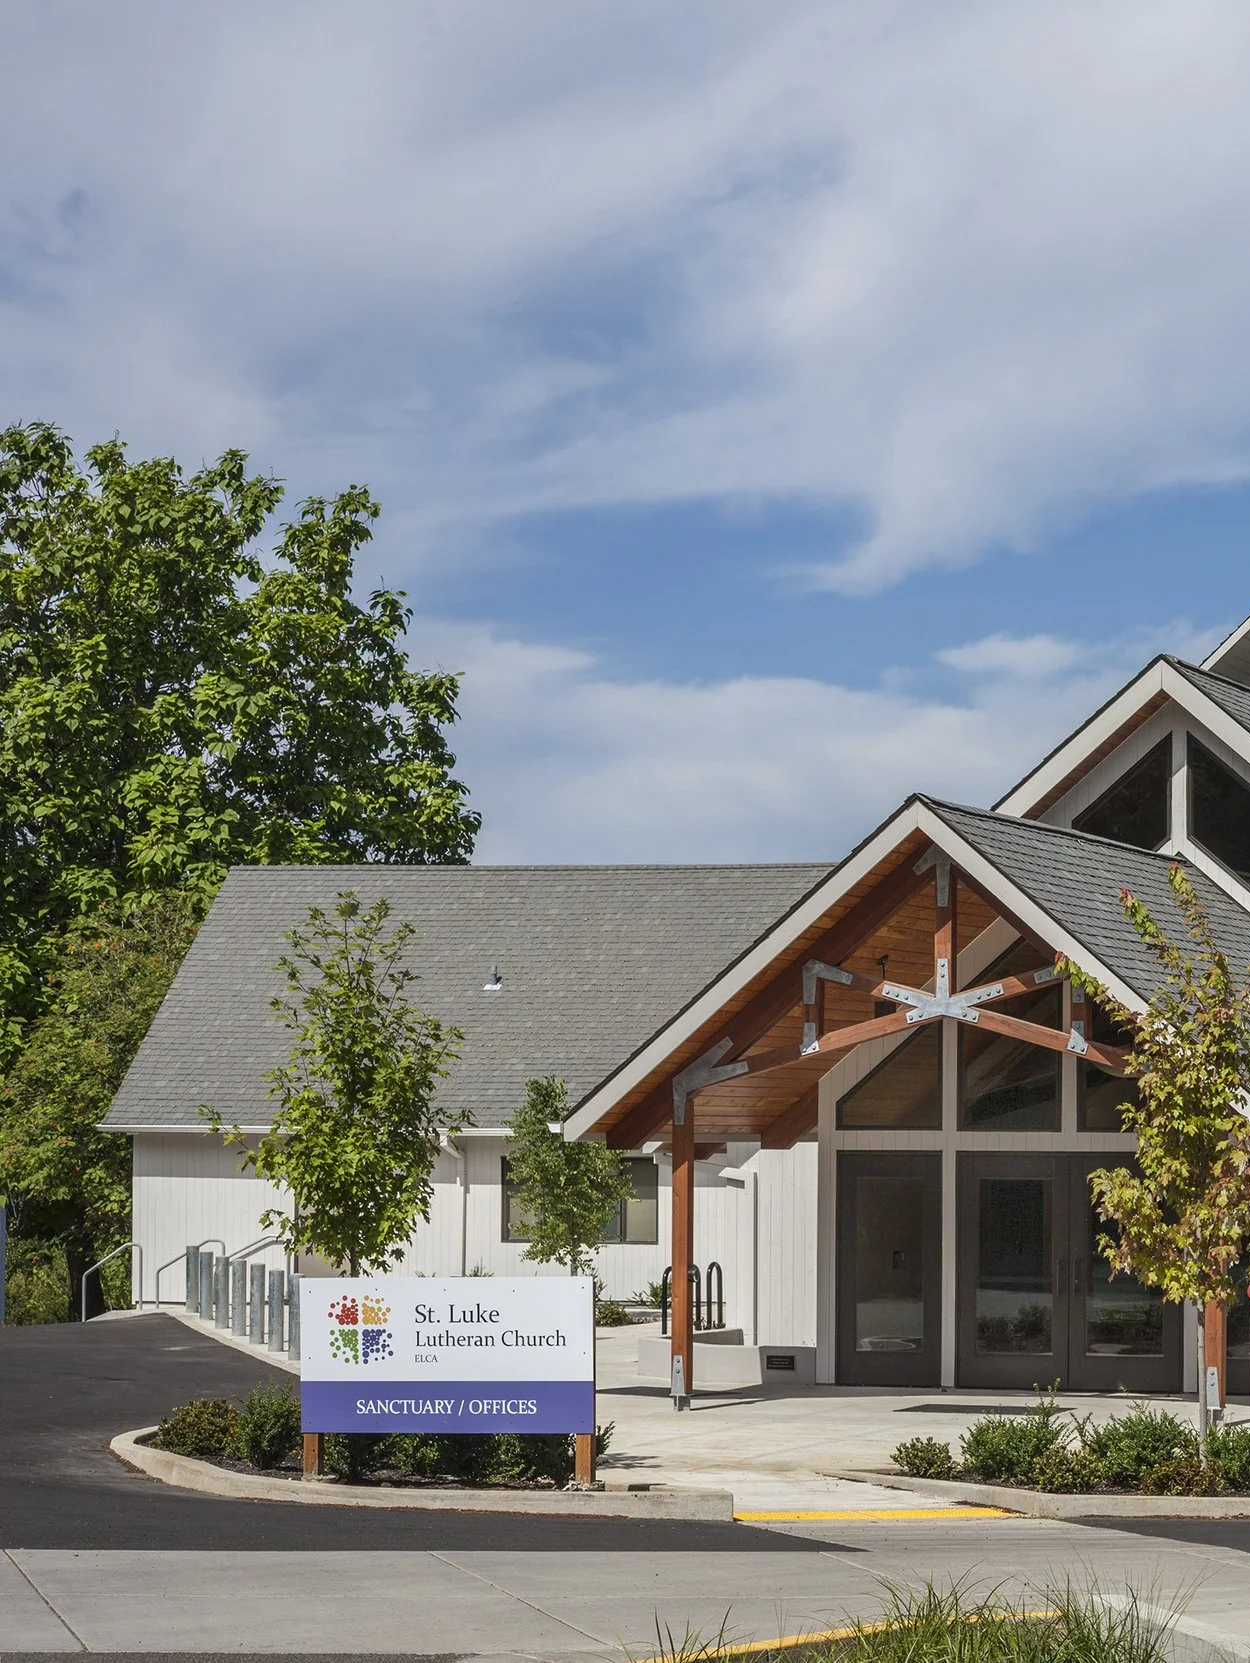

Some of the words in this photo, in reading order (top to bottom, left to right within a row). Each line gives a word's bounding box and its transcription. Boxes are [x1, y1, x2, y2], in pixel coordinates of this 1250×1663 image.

[414, 1304, 441, 1324] St.
[449, 1303, 501, 1324] Luke
[415, 1331, 495, 1347] Lutheran
[501, 1330, 567, 1347] Church
[414, 1354, 438, 1363] ELCA
[356, 1399, 455, 1415] SANCTUARY
[458, 1400, 465, 1416] /
[468, 1399, 538, 1415] OFFICES
